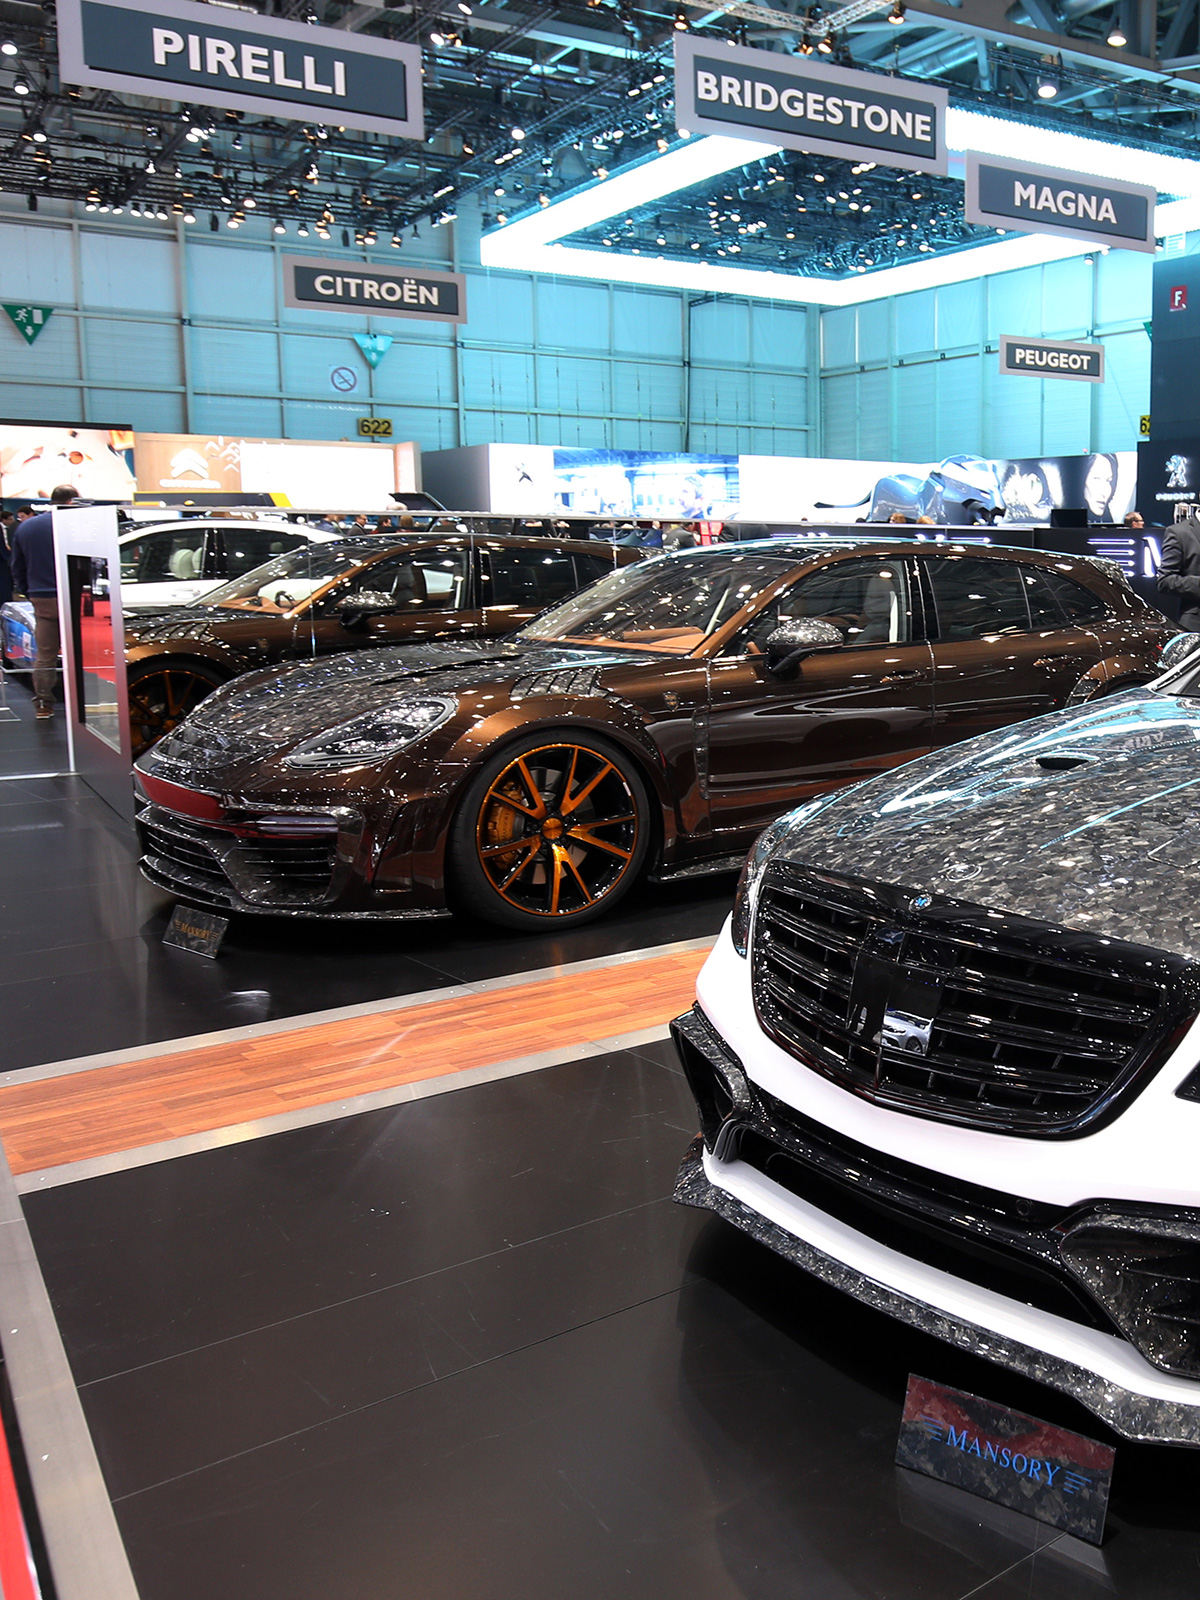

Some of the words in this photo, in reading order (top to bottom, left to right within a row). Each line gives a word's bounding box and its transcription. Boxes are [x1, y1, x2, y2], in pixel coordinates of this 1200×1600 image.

[152, 27, 347, 96] PIRELLI
[697, 70, 932, 142] BRIDGESTONE
[1014, 180, 1117, 224] MAGNA
[314, 274, 439, 306] CITROËN
[1174, 290, 1183, 306] F
[1015, 348, 1092, 370] PEUGEOT
[361, 419, 392, 435] 622
[946, 1425, 1061, 1486] MANSORY
